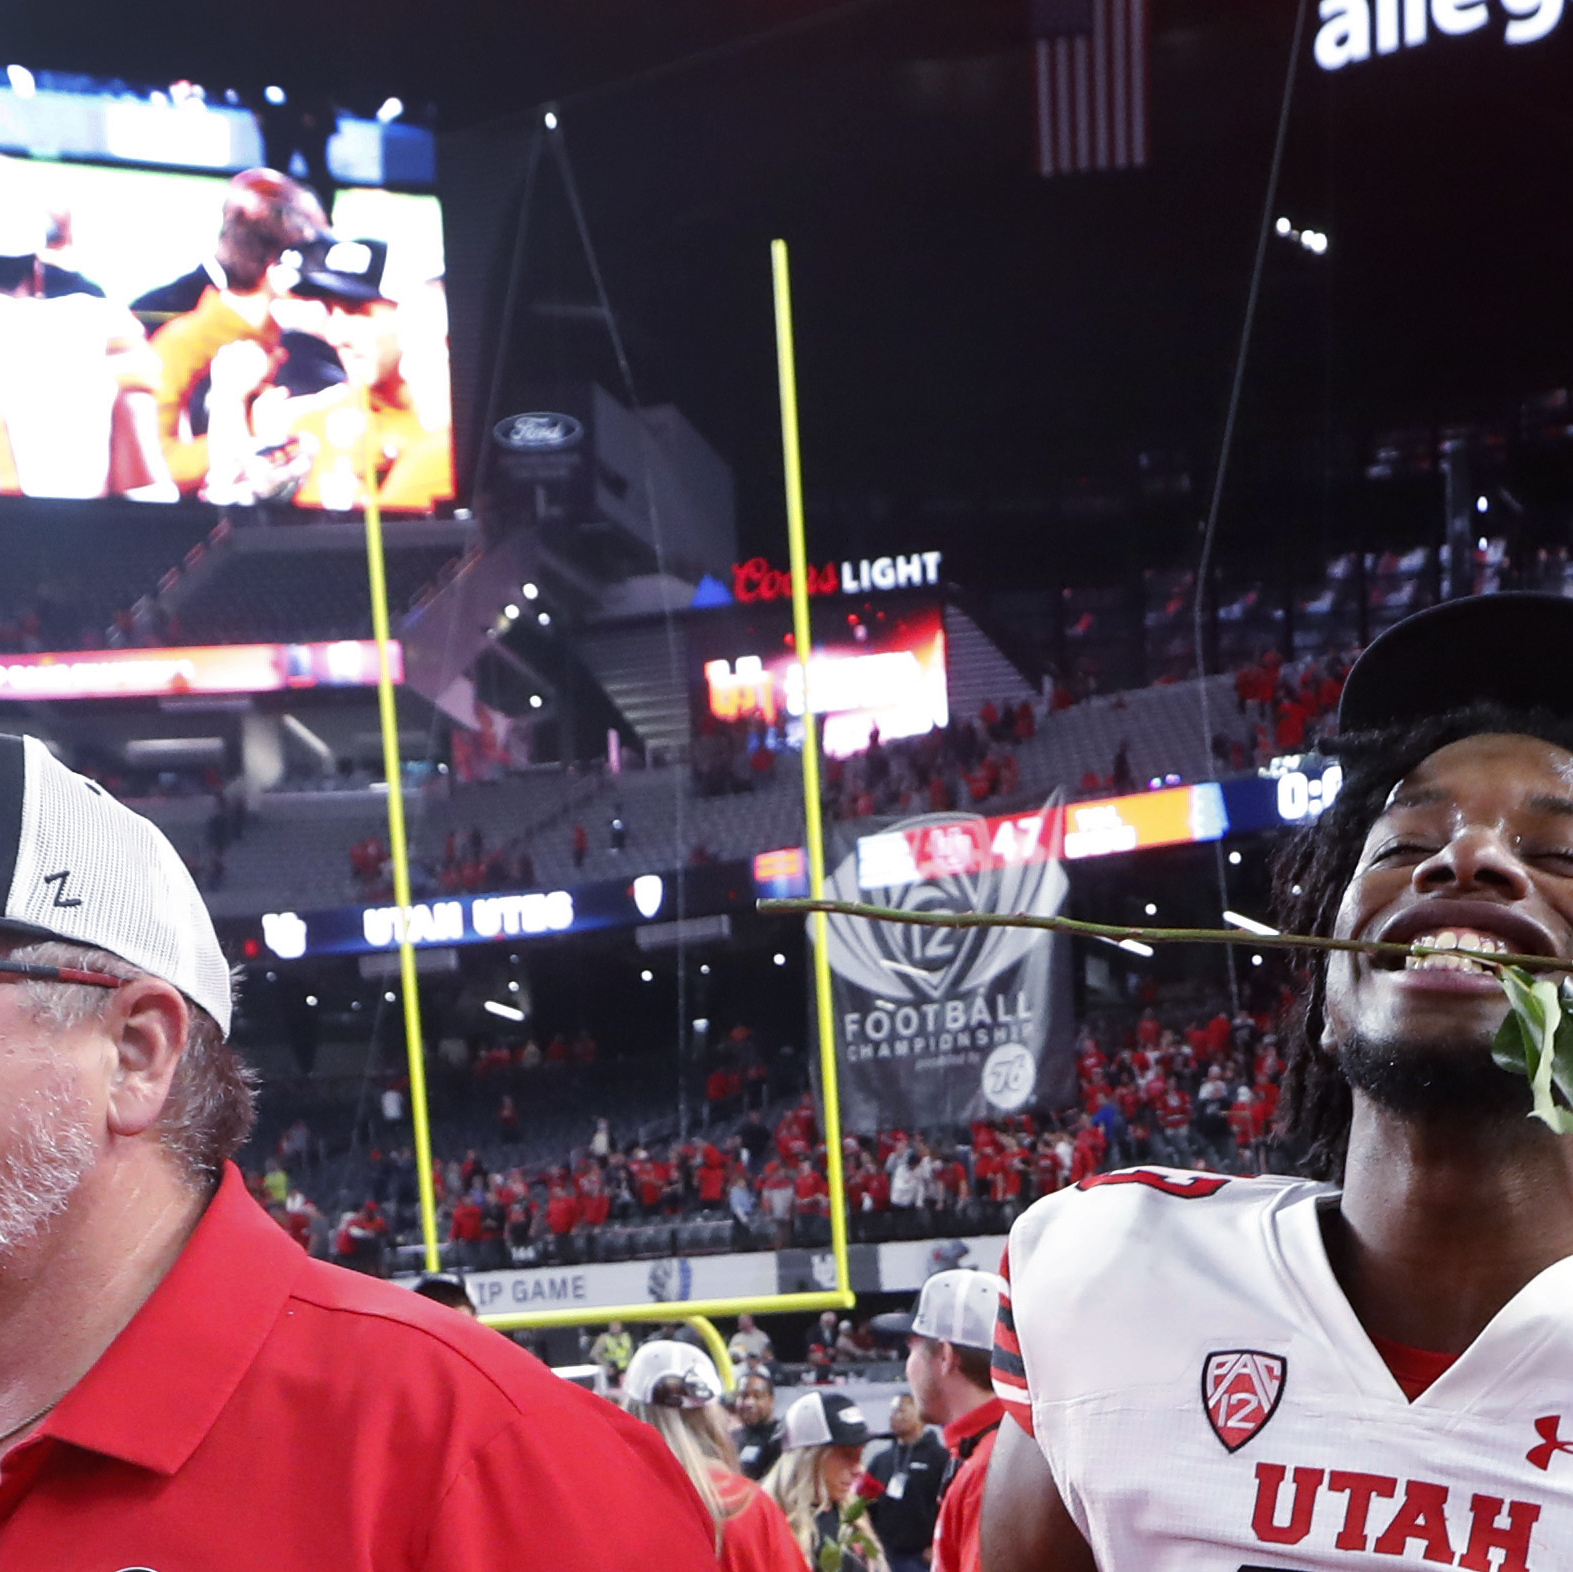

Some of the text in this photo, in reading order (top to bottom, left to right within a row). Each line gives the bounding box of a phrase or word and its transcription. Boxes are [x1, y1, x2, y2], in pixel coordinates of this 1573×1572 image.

[841, 551, 942, 594] LIGHT
[843, 992, 1032, 1042] FOOTBALL
[846, 1021, 1035, 1063] CHAMPIONSHIP
[510, 1274, 588, 1304] GAME
[1207, 1353, 1282, 1413] PAC
[1217, 1391, 1259, 1430] 12
